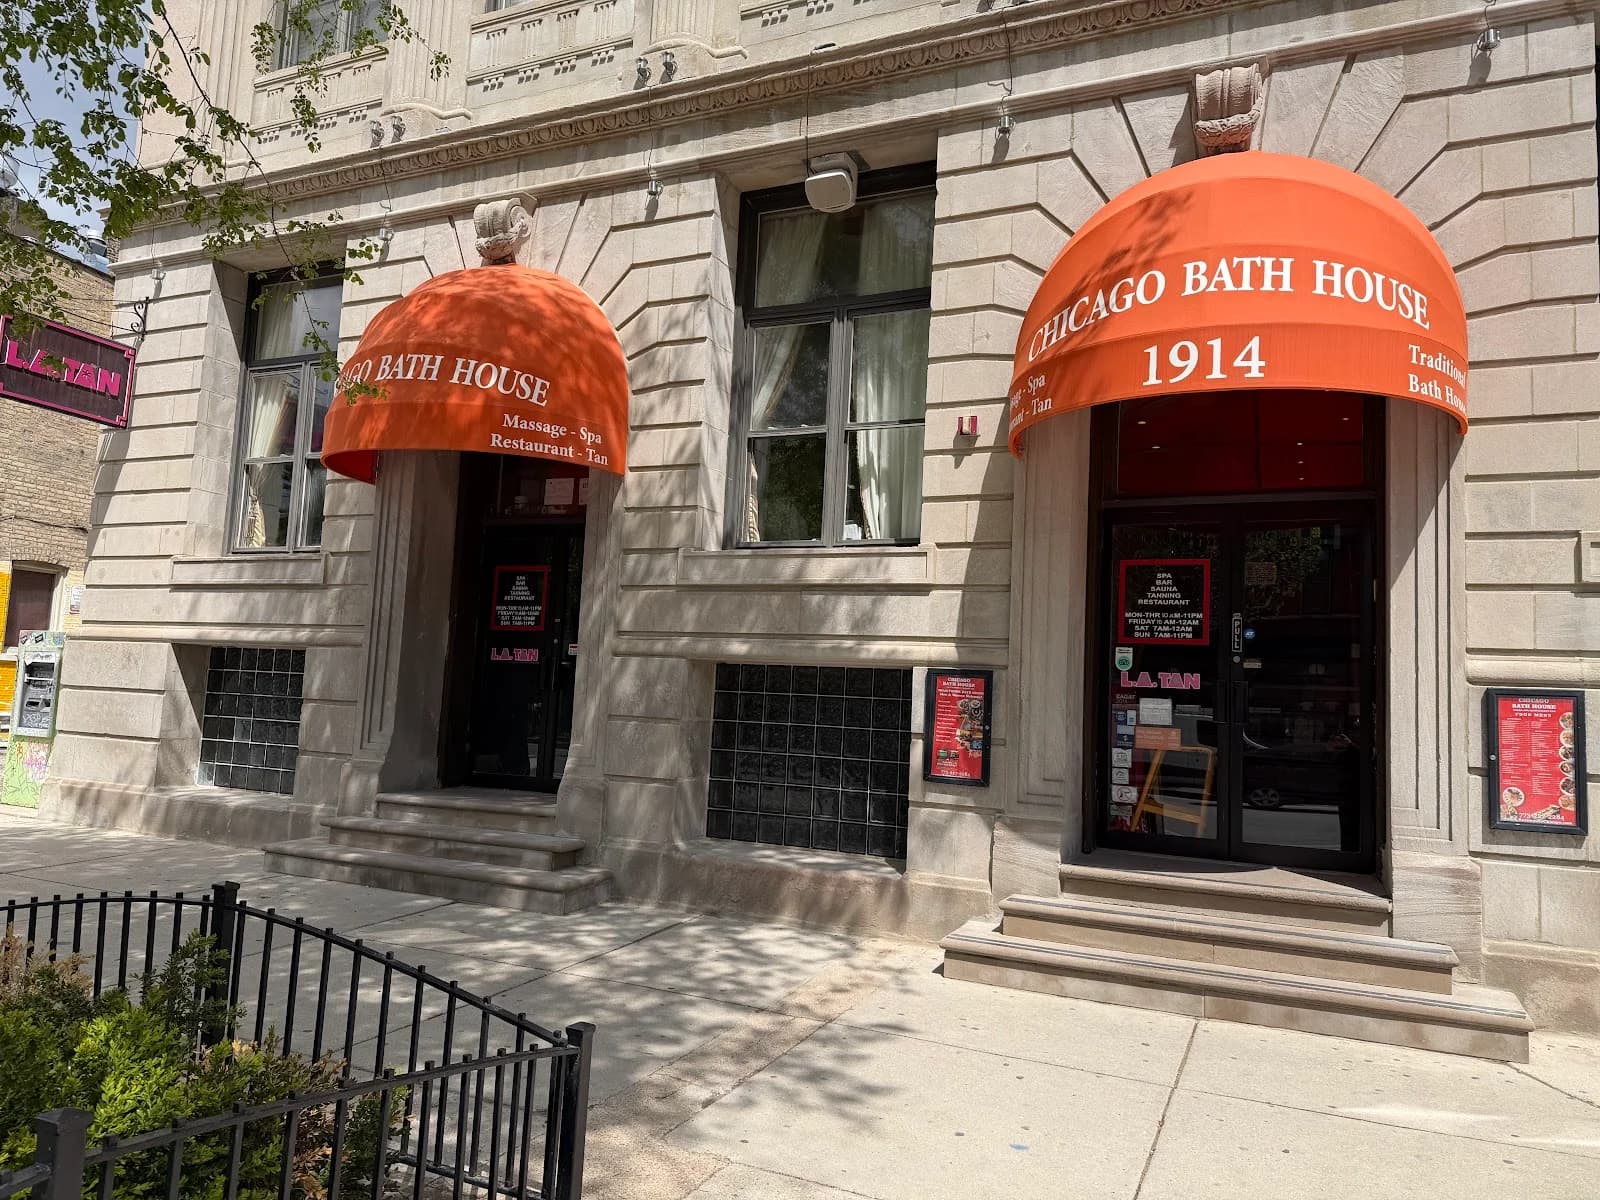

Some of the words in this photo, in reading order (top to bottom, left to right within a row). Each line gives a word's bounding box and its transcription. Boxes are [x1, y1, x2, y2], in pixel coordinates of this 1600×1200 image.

[1028, 270, 1166, 362] CHICAGO
[1181, 256, 1295, 297] BATH
[1312, 259, 1431, 330] HOUSE
[62, 356, 122, 398] TAN
[1142, 335, 1266, 386] 1914
[375, 353, 444, 381] BATH
[450, 357, 550, 407] HOUSE
[1028, 374, 1046, 396] Spa
[1408, 373, 1442, 400] Bath
[1032, 397, 1052, 416] Tan
[502, 413, 568, 438] Massage
[580, 426, 602, 446] Spa
[490, 433, 574, 458] Restaurant
[586, 448, 608, 466] Tan
[491, 647, 513, 661] L.A.
[514, 648, 539, 662] TAN
[1120, 671, 1158, 688] L.A.
[1158, 672, 1200, 690] TAN
